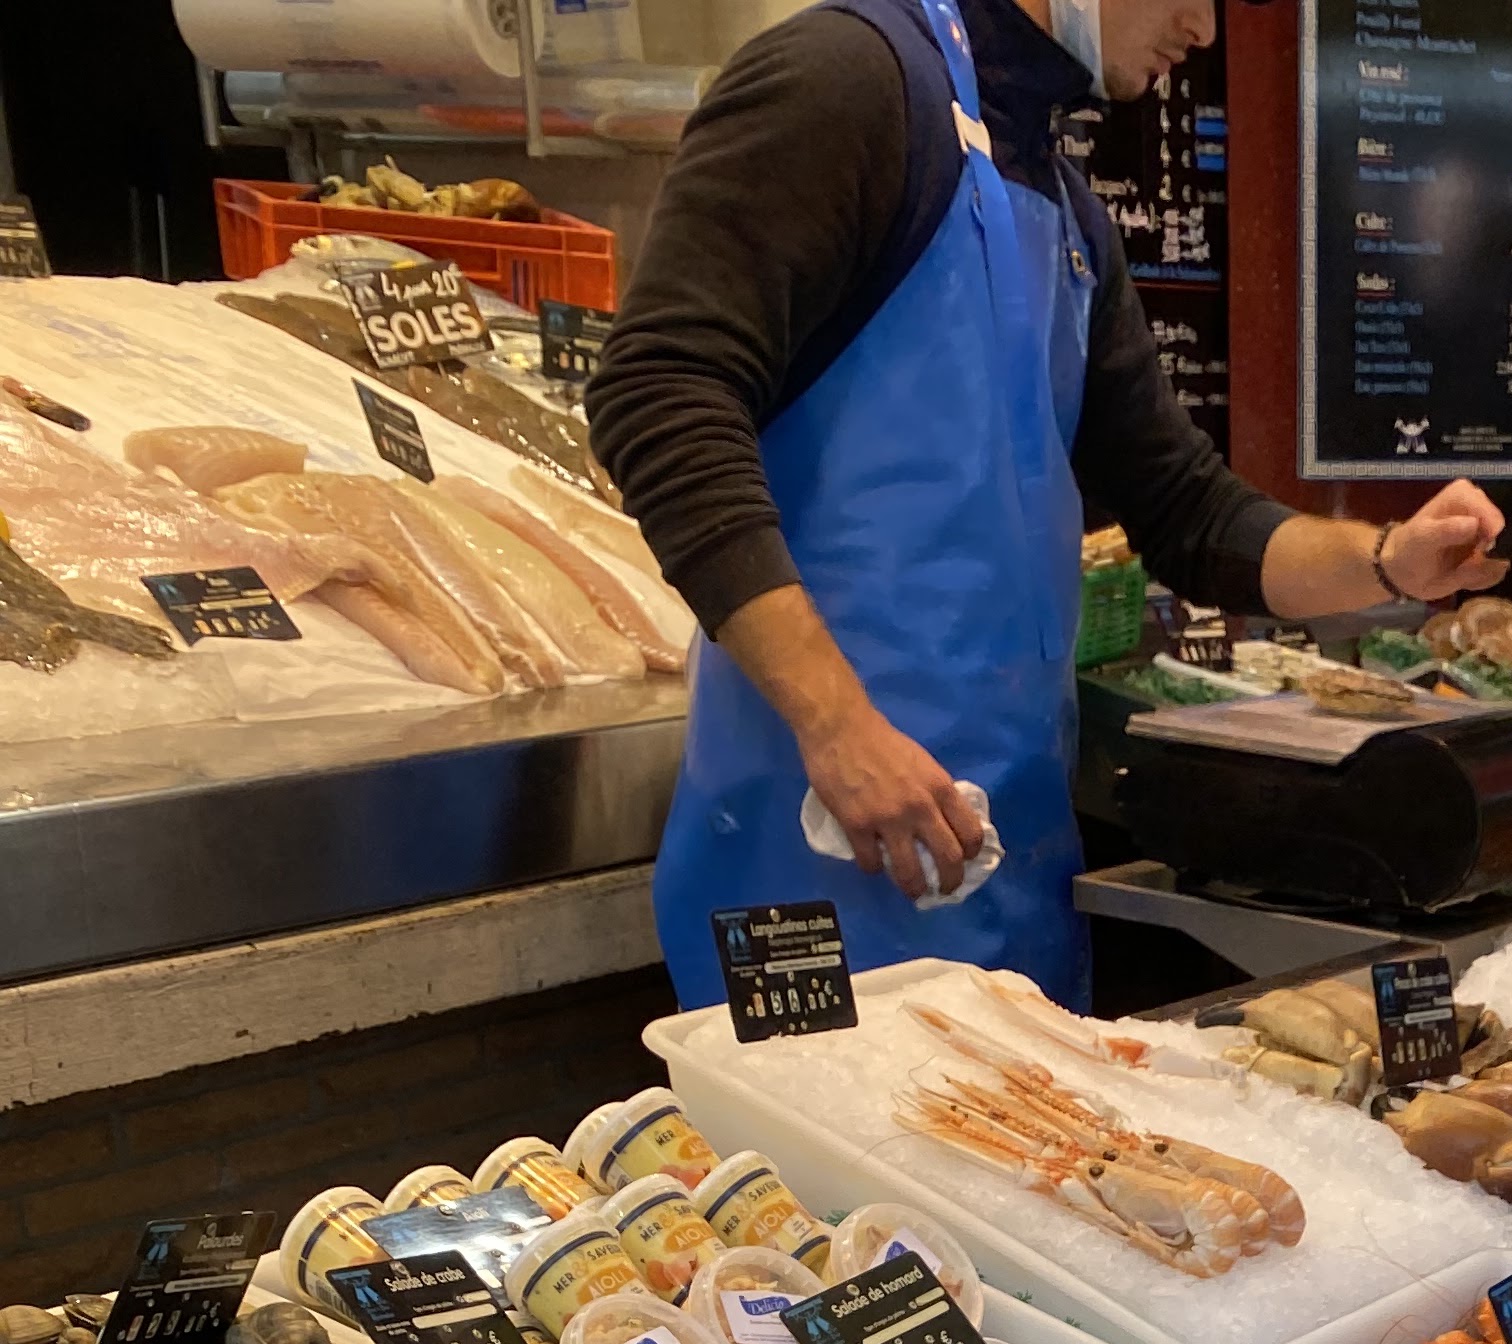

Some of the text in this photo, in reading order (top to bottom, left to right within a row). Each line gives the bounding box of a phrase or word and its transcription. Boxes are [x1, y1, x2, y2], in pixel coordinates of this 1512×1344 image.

[367, 302, 482, 352] SOLES
[639, 1221, 661, 1243] MER
[720, 1214, 742, 1237] MER
[552, 1272, 576, 1295] MER
[831, 1265, 924, 1319] Salade de homard
